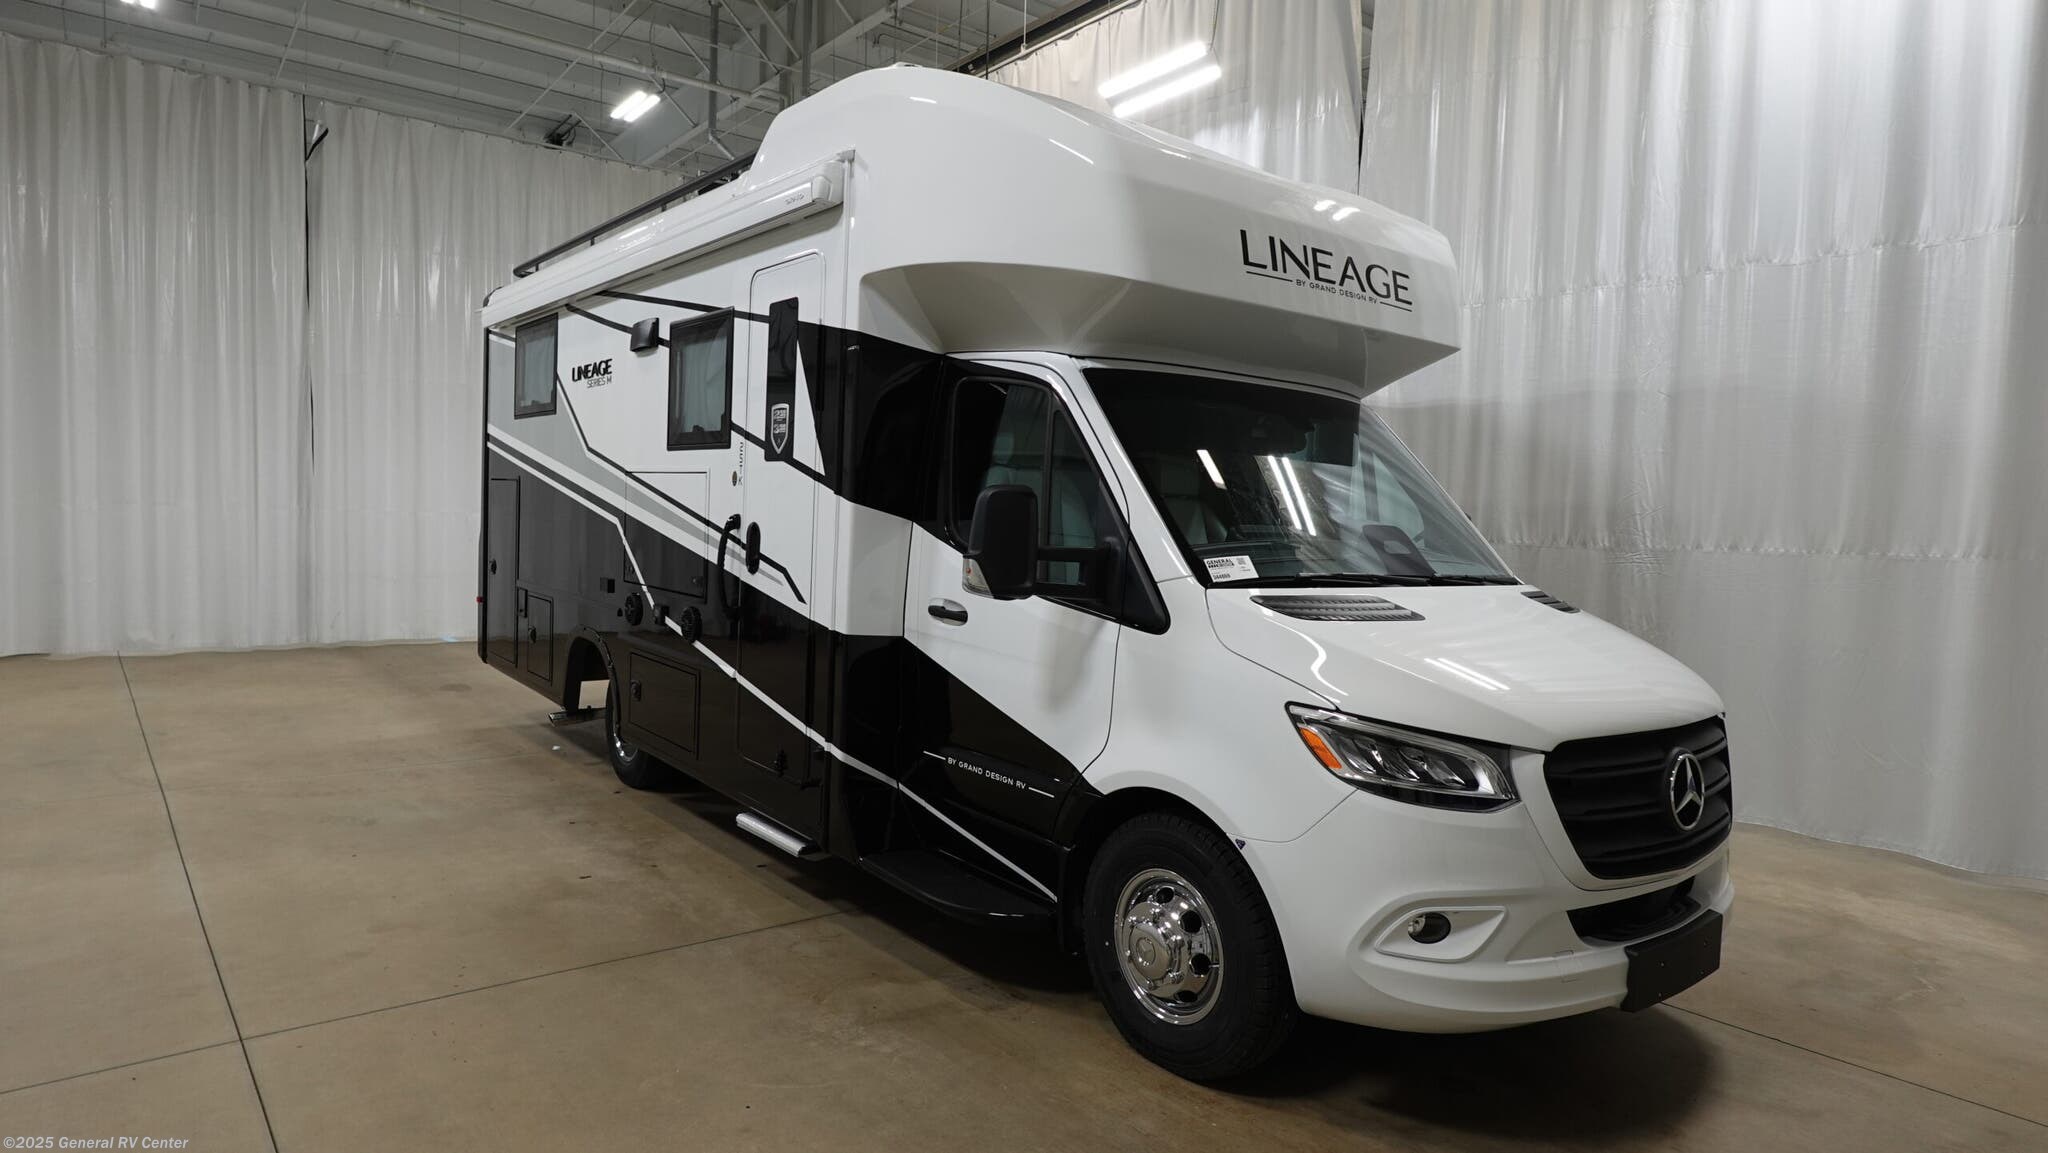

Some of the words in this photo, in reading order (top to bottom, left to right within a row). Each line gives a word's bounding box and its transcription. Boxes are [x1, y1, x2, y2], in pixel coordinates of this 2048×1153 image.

[1240, 229, 1413, 306] LINEAGE
[1295, 279, 1306, 287] BY
[1309, 282, 1337, 295] GRAND
[1339, 289, 1367, 302] DESIGN
[1368, 296, 1378, 304] RV
[572, 358, 613, 382] LINEAGE
[587, 376, 606, 389] SERIES
[1206, 558, 1233, 566] GENERAL
[947, 757, 957, 765] BY
[958, 761, 983, 775] GRAND
[985, 770, 1014, 786] DESIGN
[1016, 780, 1026, 789] RV
